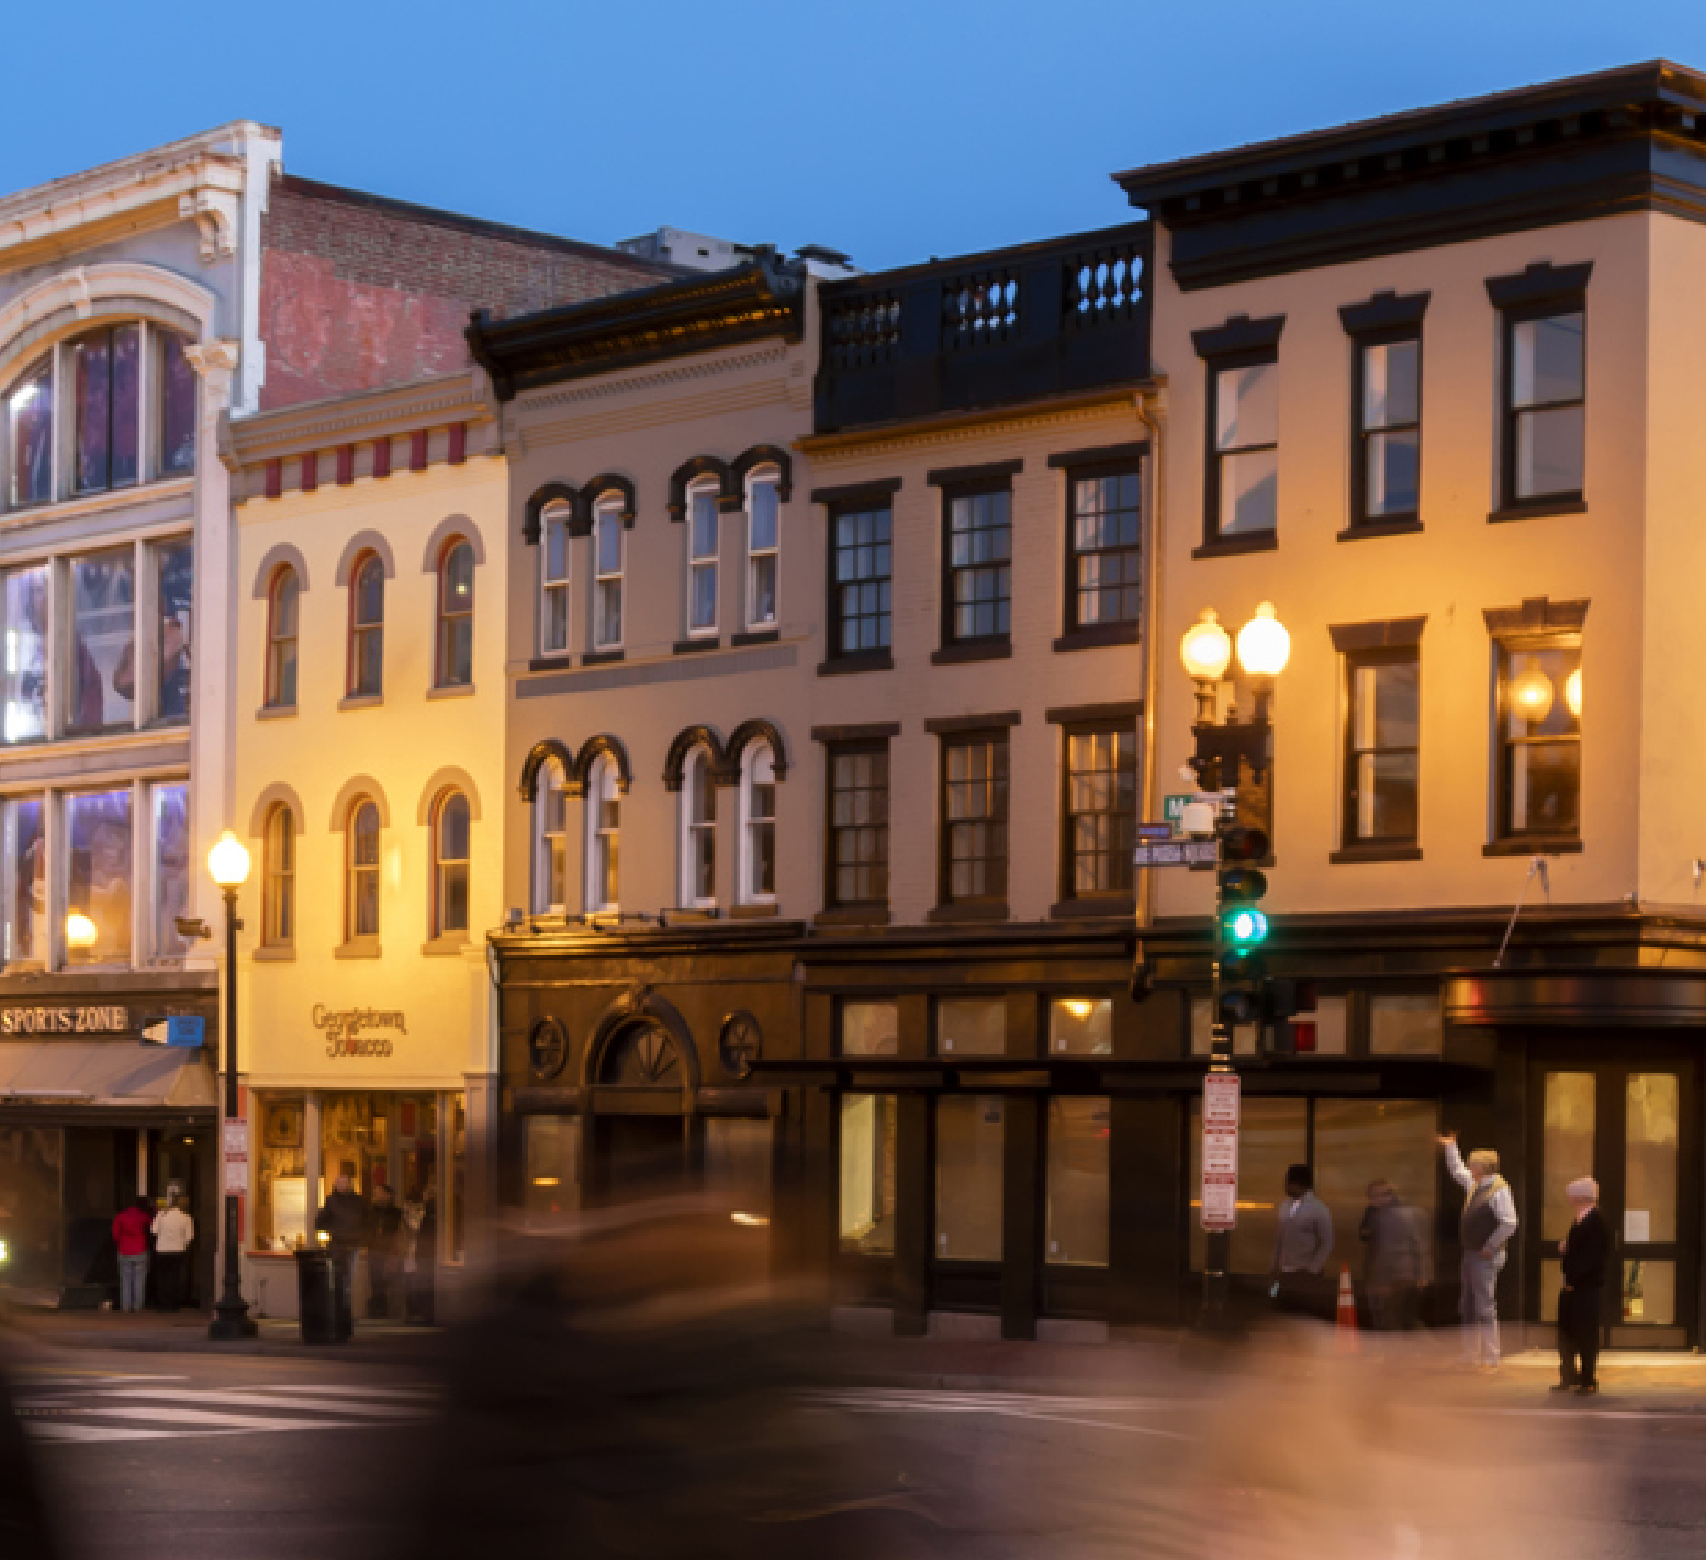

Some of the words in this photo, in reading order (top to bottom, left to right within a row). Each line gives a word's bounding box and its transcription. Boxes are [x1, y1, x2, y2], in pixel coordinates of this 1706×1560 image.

[1, 1007, 73, 1034] SPORTS
[75, 1006, 128, 1032] ZONE
[311, 1002, 407, 1036] Georgetown
